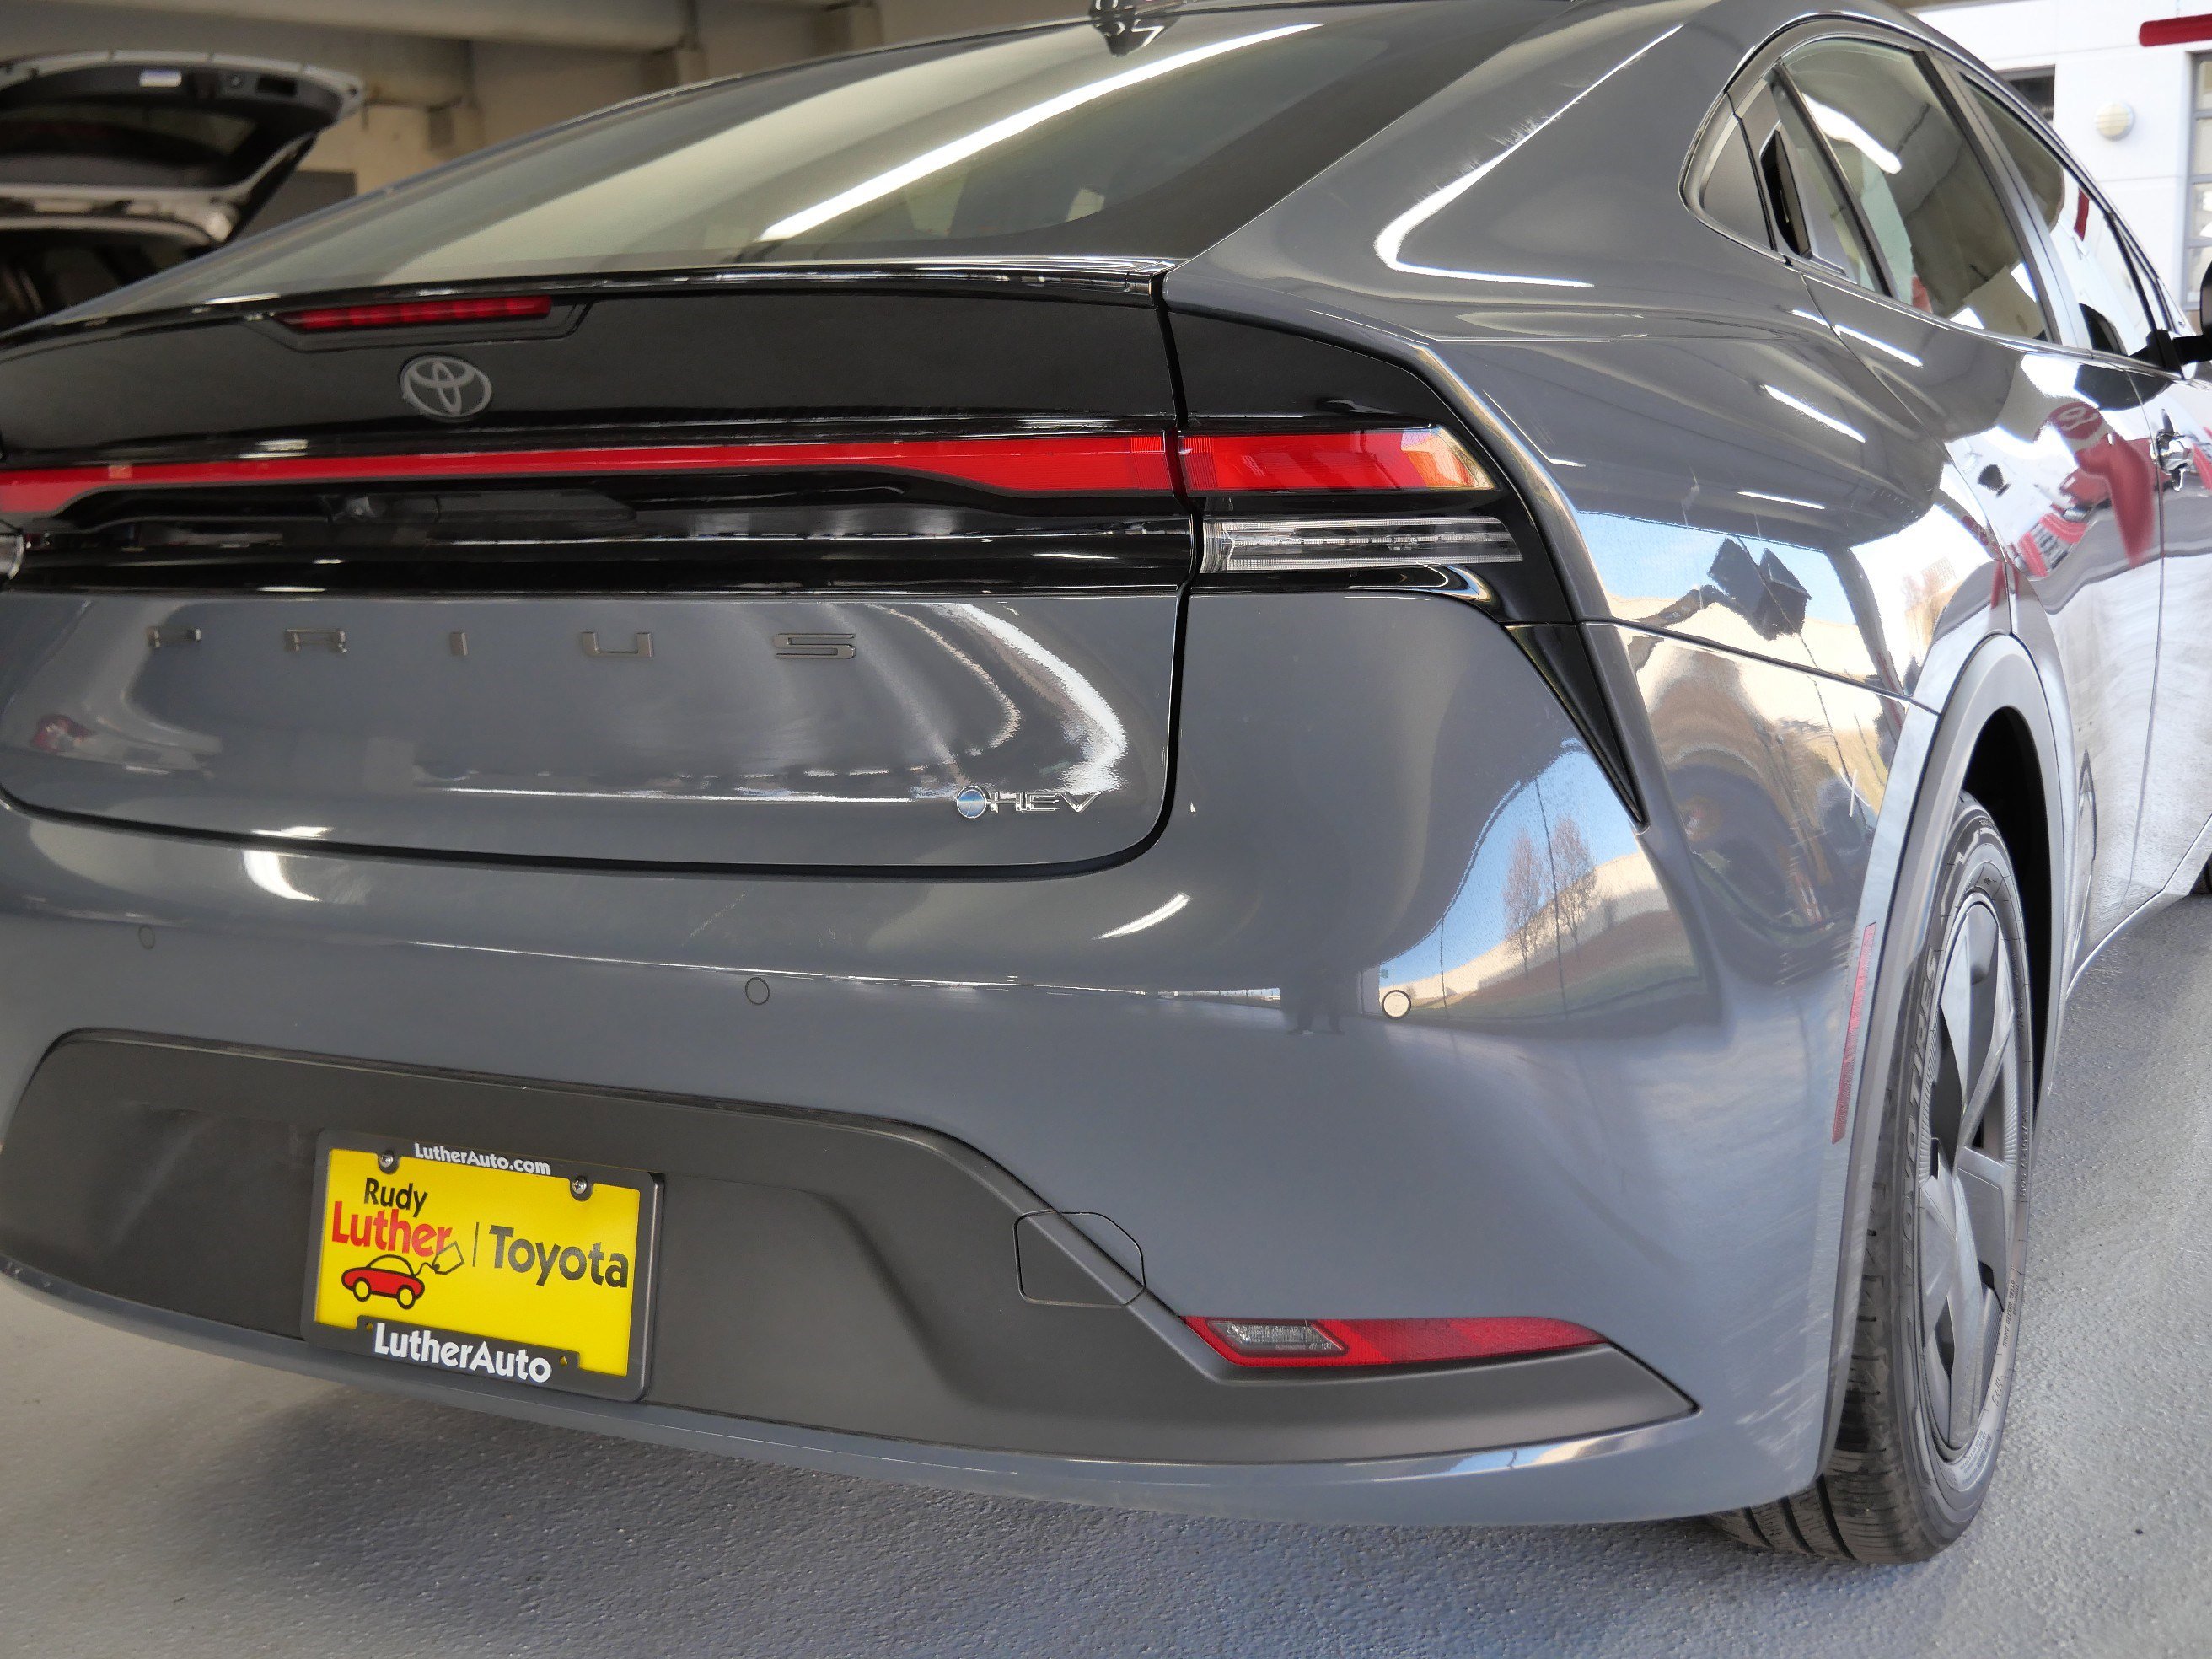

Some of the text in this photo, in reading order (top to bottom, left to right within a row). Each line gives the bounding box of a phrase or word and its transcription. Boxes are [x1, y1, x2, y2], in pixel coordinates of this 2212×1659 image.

[985, 791, 1102, 813] HEV
[1902, 944, 1936, 1275] TOYO TIRES
[414, 1142, 551, 1176] LutherAuto.com
[363, 1178, 428, 1217] Rudy
[331, 1200, 453, 1257] Luther
[488, 1224, 629, 1288] Toyota
[373, 1322, 552, 1383] LutherAuto
